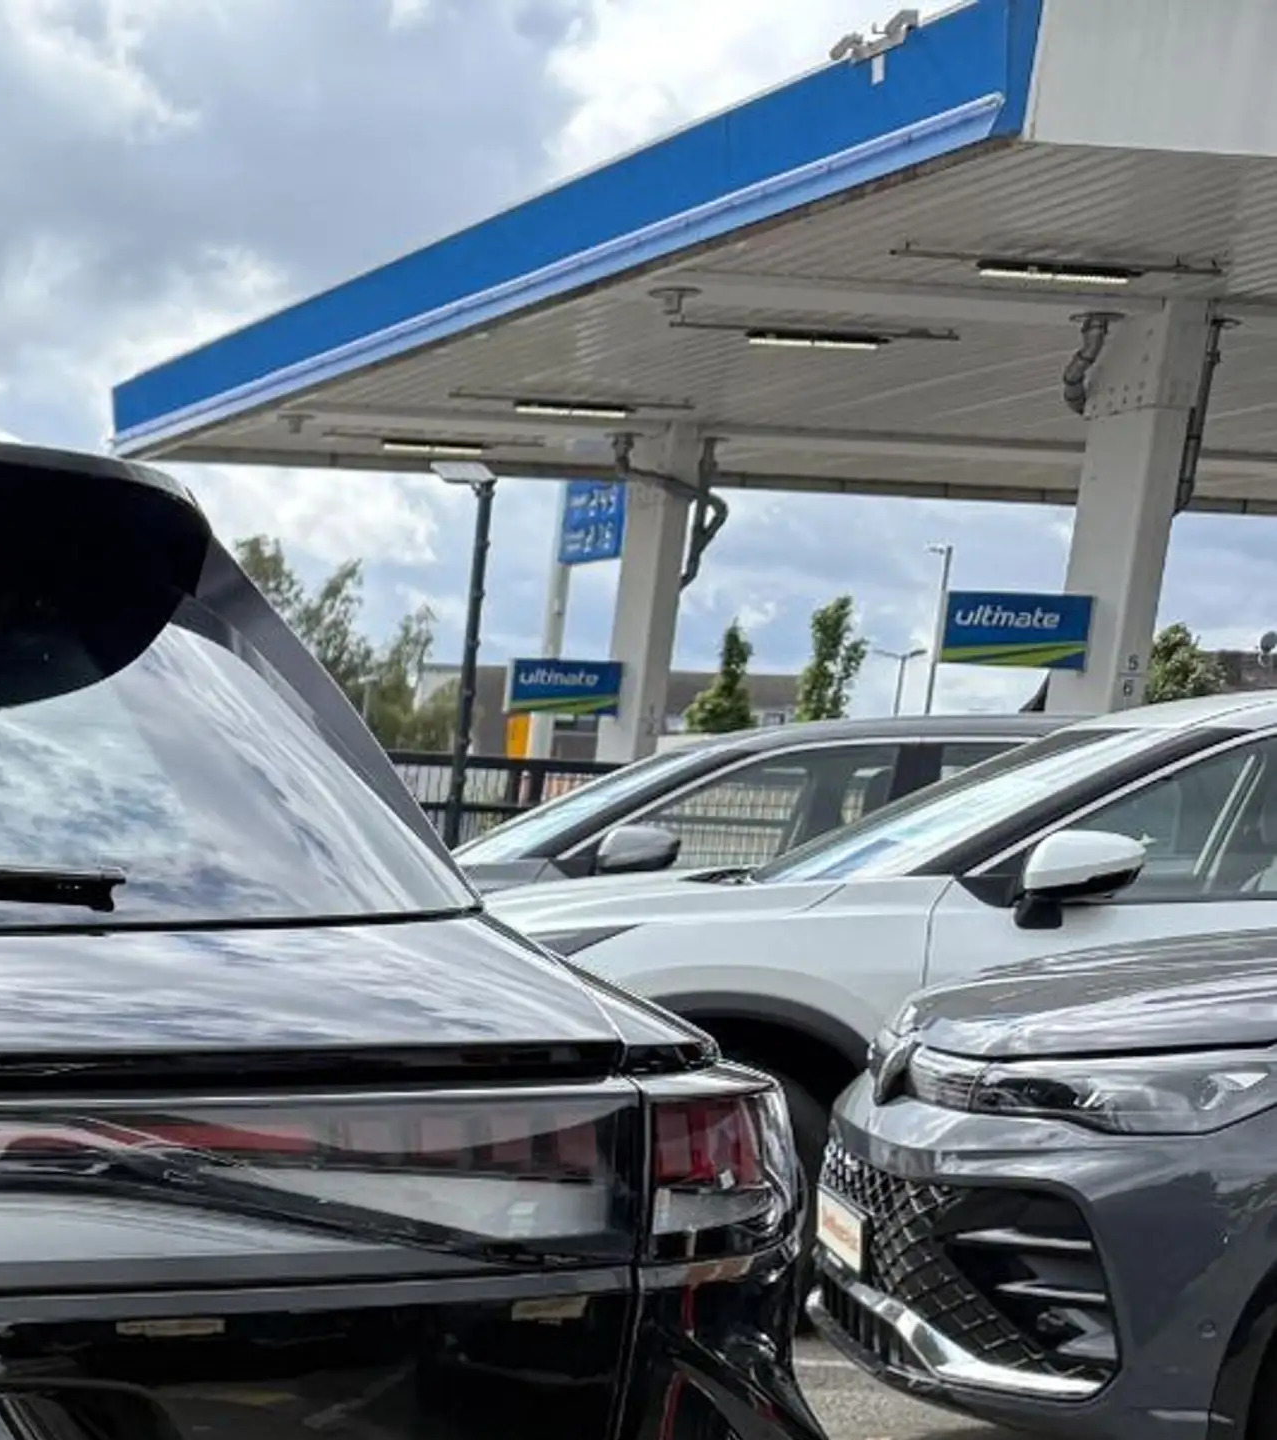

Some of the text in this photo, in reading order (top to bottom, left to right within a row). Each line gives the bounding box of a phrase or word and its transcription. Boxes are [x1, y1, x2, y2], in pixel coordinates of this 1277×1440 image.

[954, 604, 1060, 629] ultimate
[1128, 654, 1139, 671] 5
[519, 667, 599, 687] ultimate
[1123, 679, 1134, 697] 6
